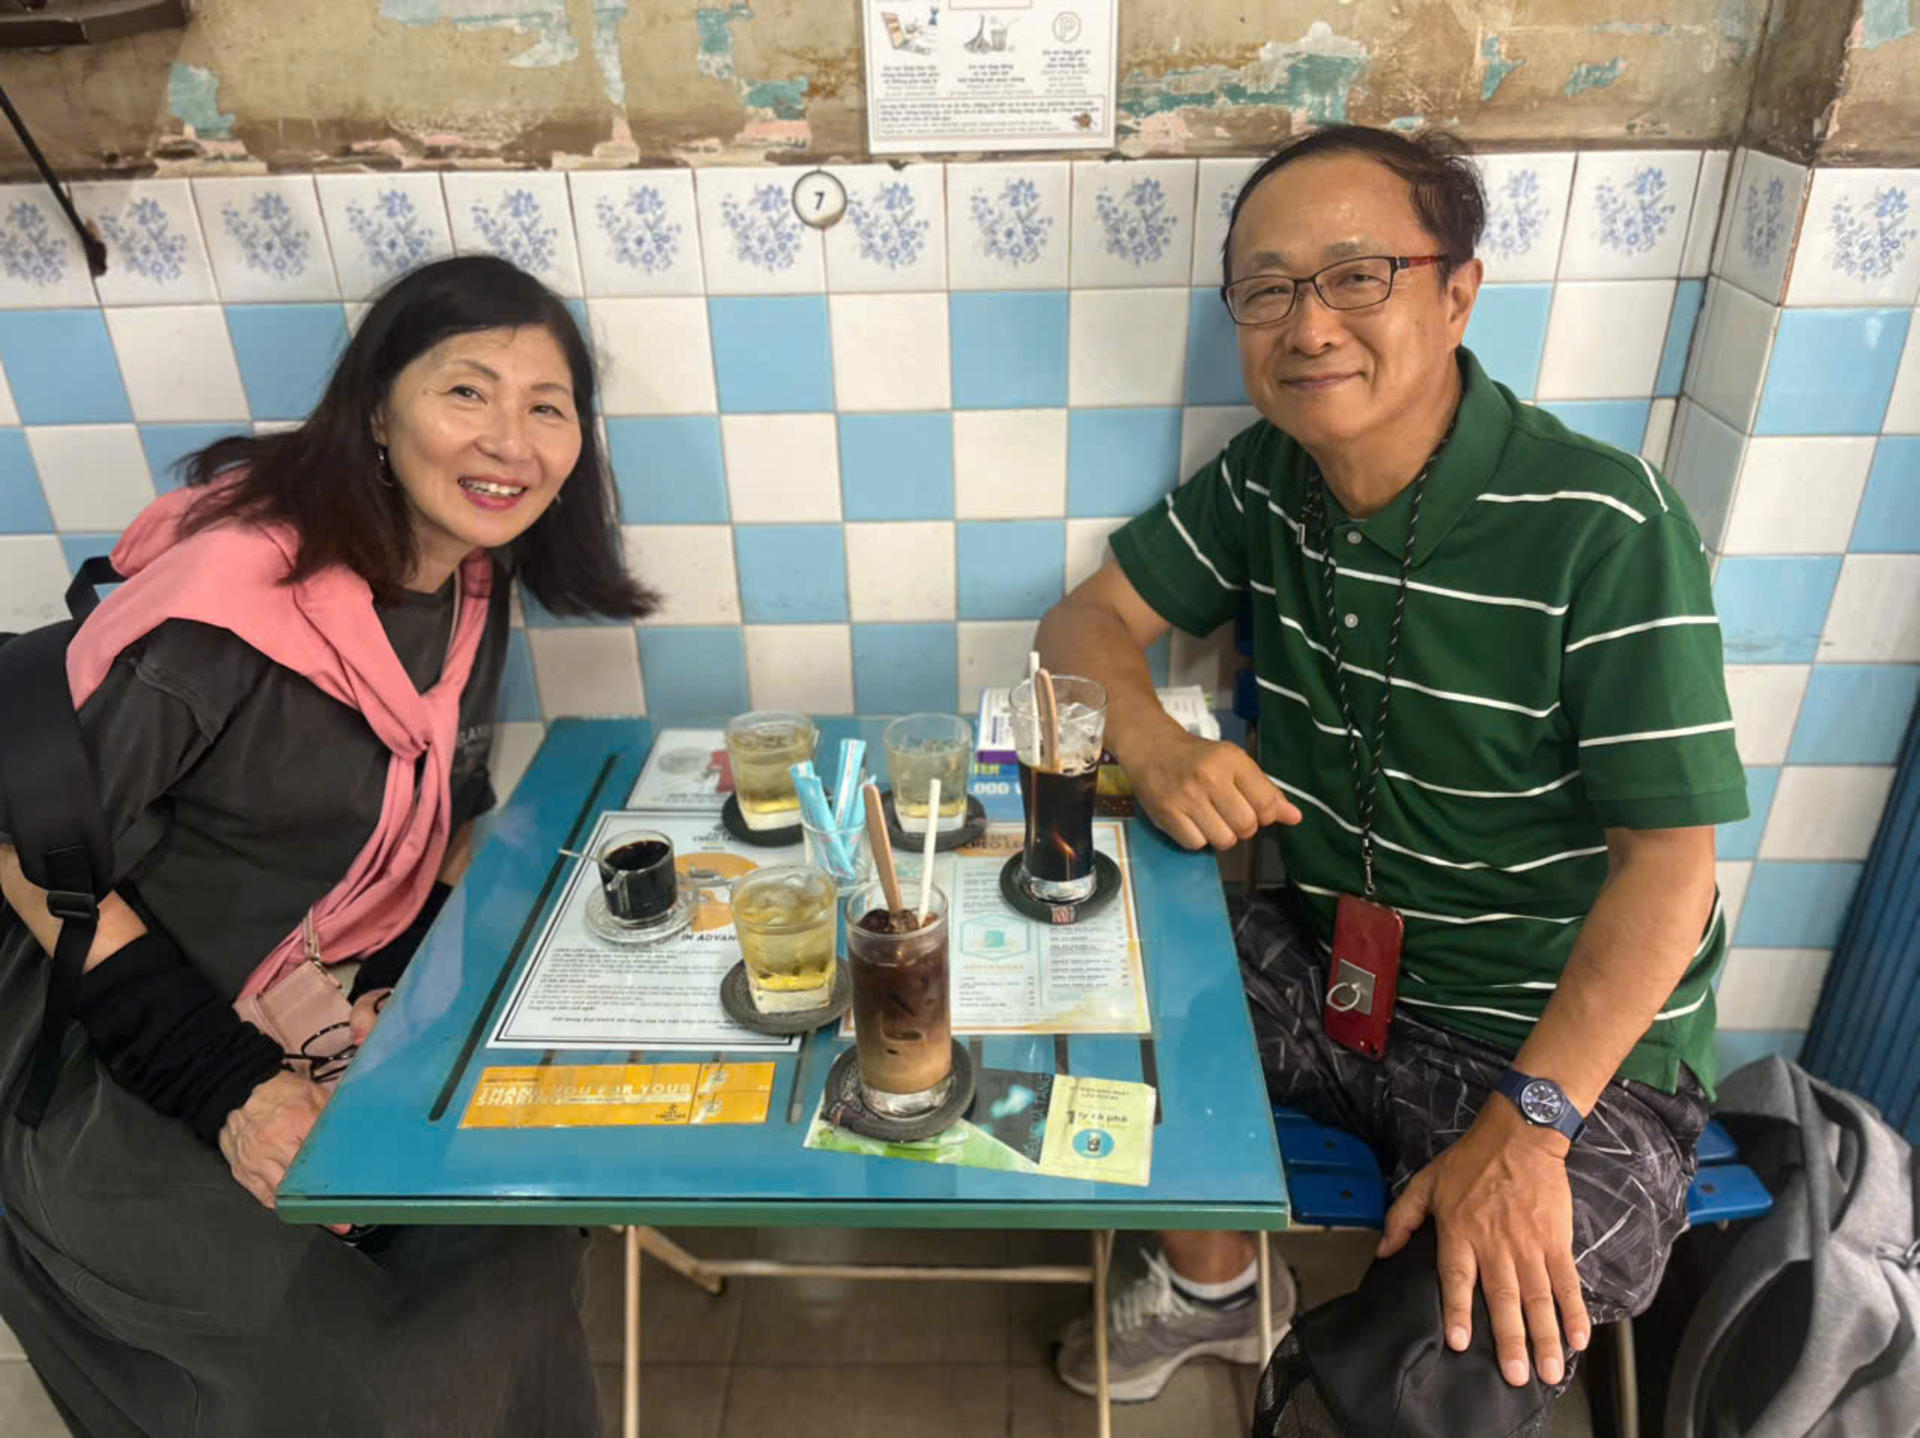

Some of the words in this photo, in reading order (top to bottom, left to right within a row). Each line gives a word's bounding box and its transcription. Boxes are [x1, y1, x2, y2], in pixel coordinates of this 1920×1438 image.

[814, 191, 825, 211] 7
[552, 1084, 591, 1095] YOU
[640, 1083, 690, 1095] YOUR
